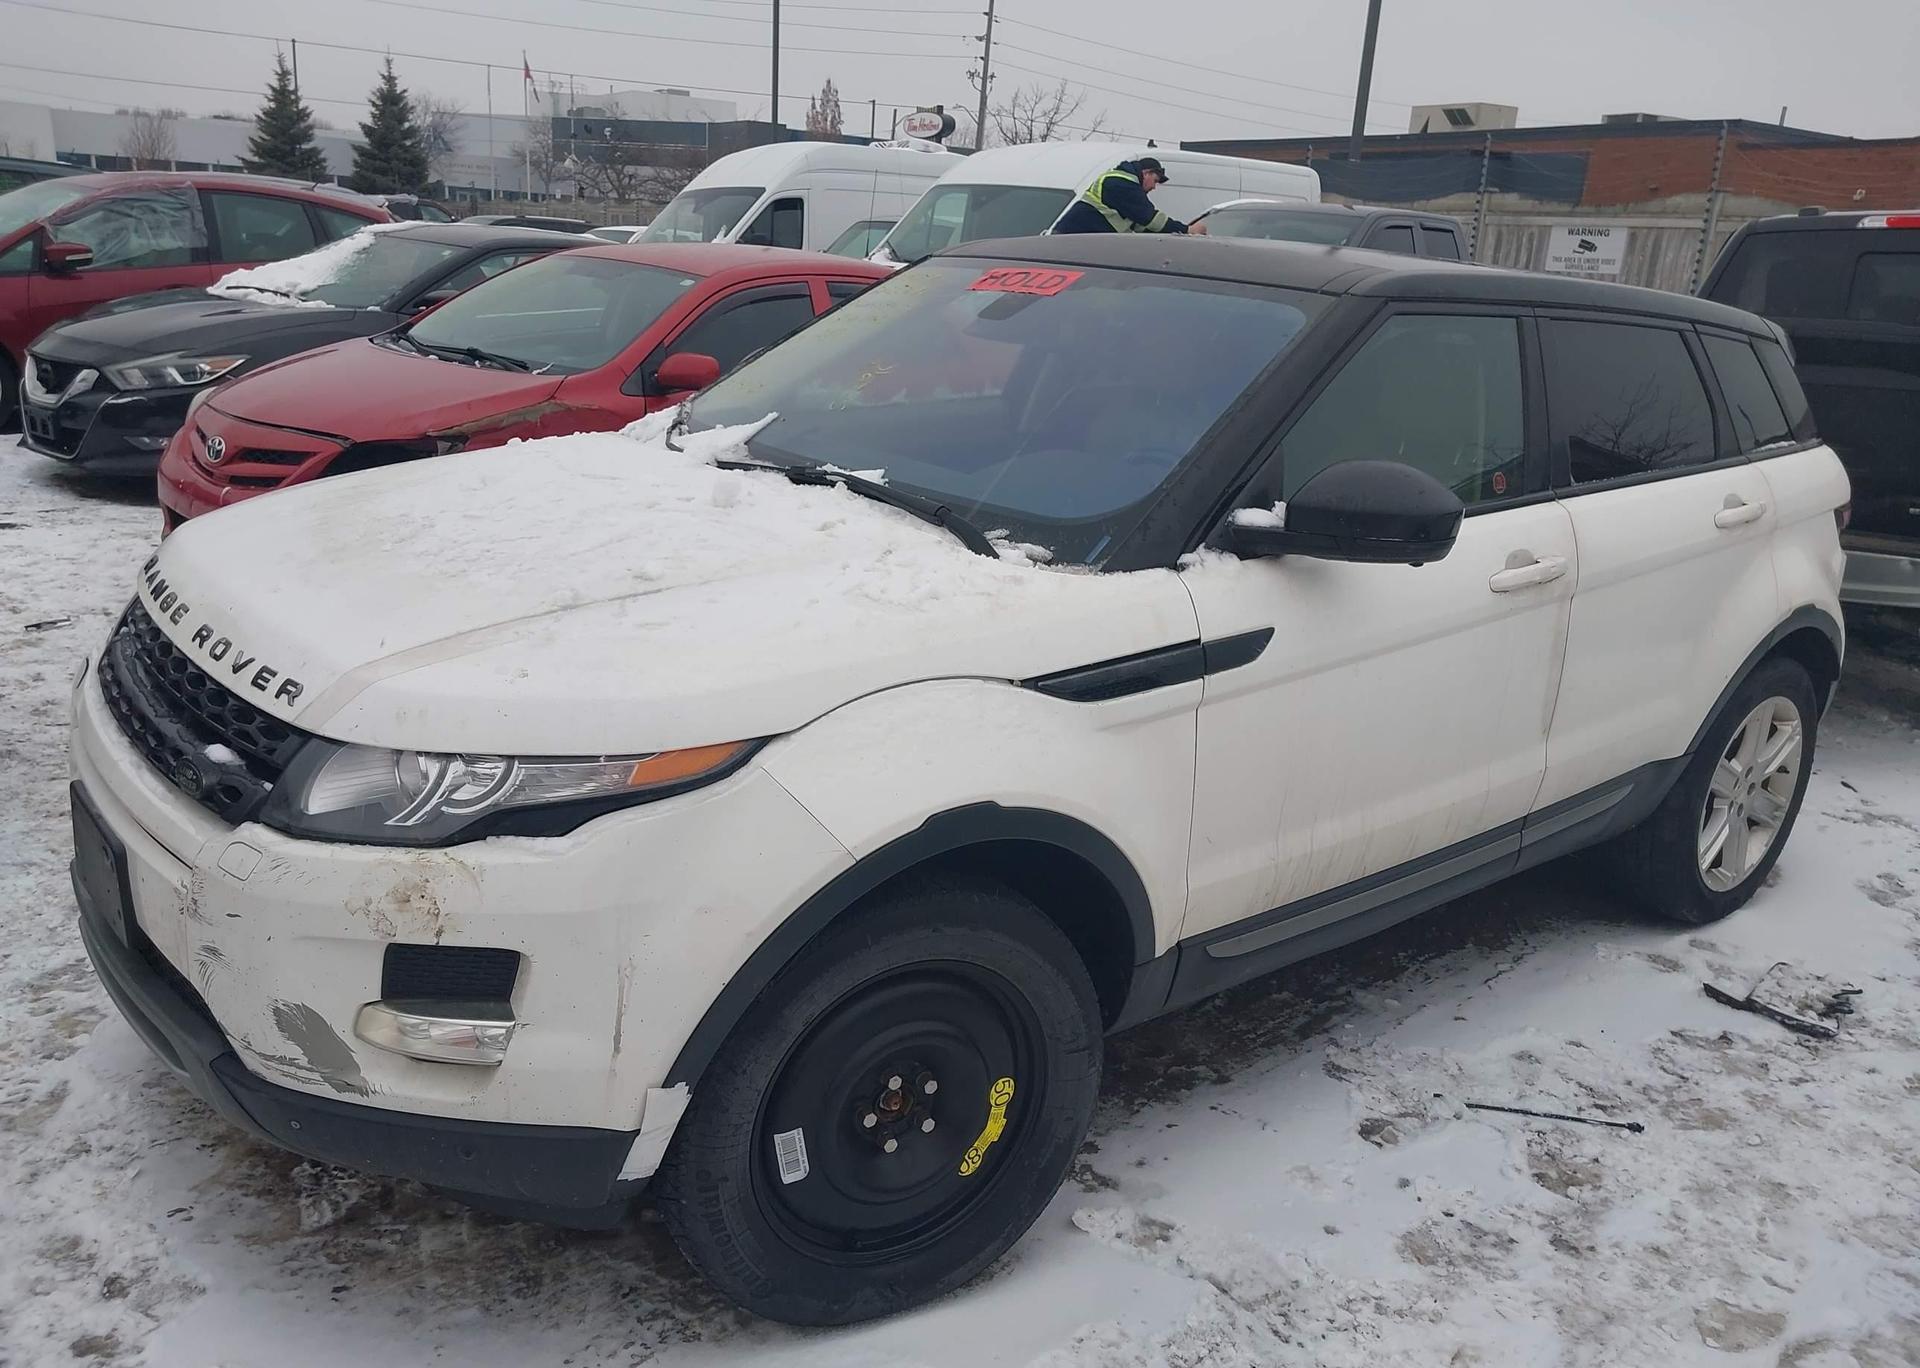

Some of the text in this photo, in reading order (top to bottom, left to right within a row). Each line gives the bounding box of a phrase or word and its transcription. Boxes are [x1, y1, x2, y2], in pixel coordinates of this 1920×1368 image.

[1567, 227, 1610, 237] WARNING
[1564, 256, 1576, 264] AREA
[1601, 258, 1616, 266] VIDEO
[978, 271, 1068, 289] HOLD
[143, 554, 304, 708] RANGE ROVER
[994, 1079, 1011, 1106] 50
